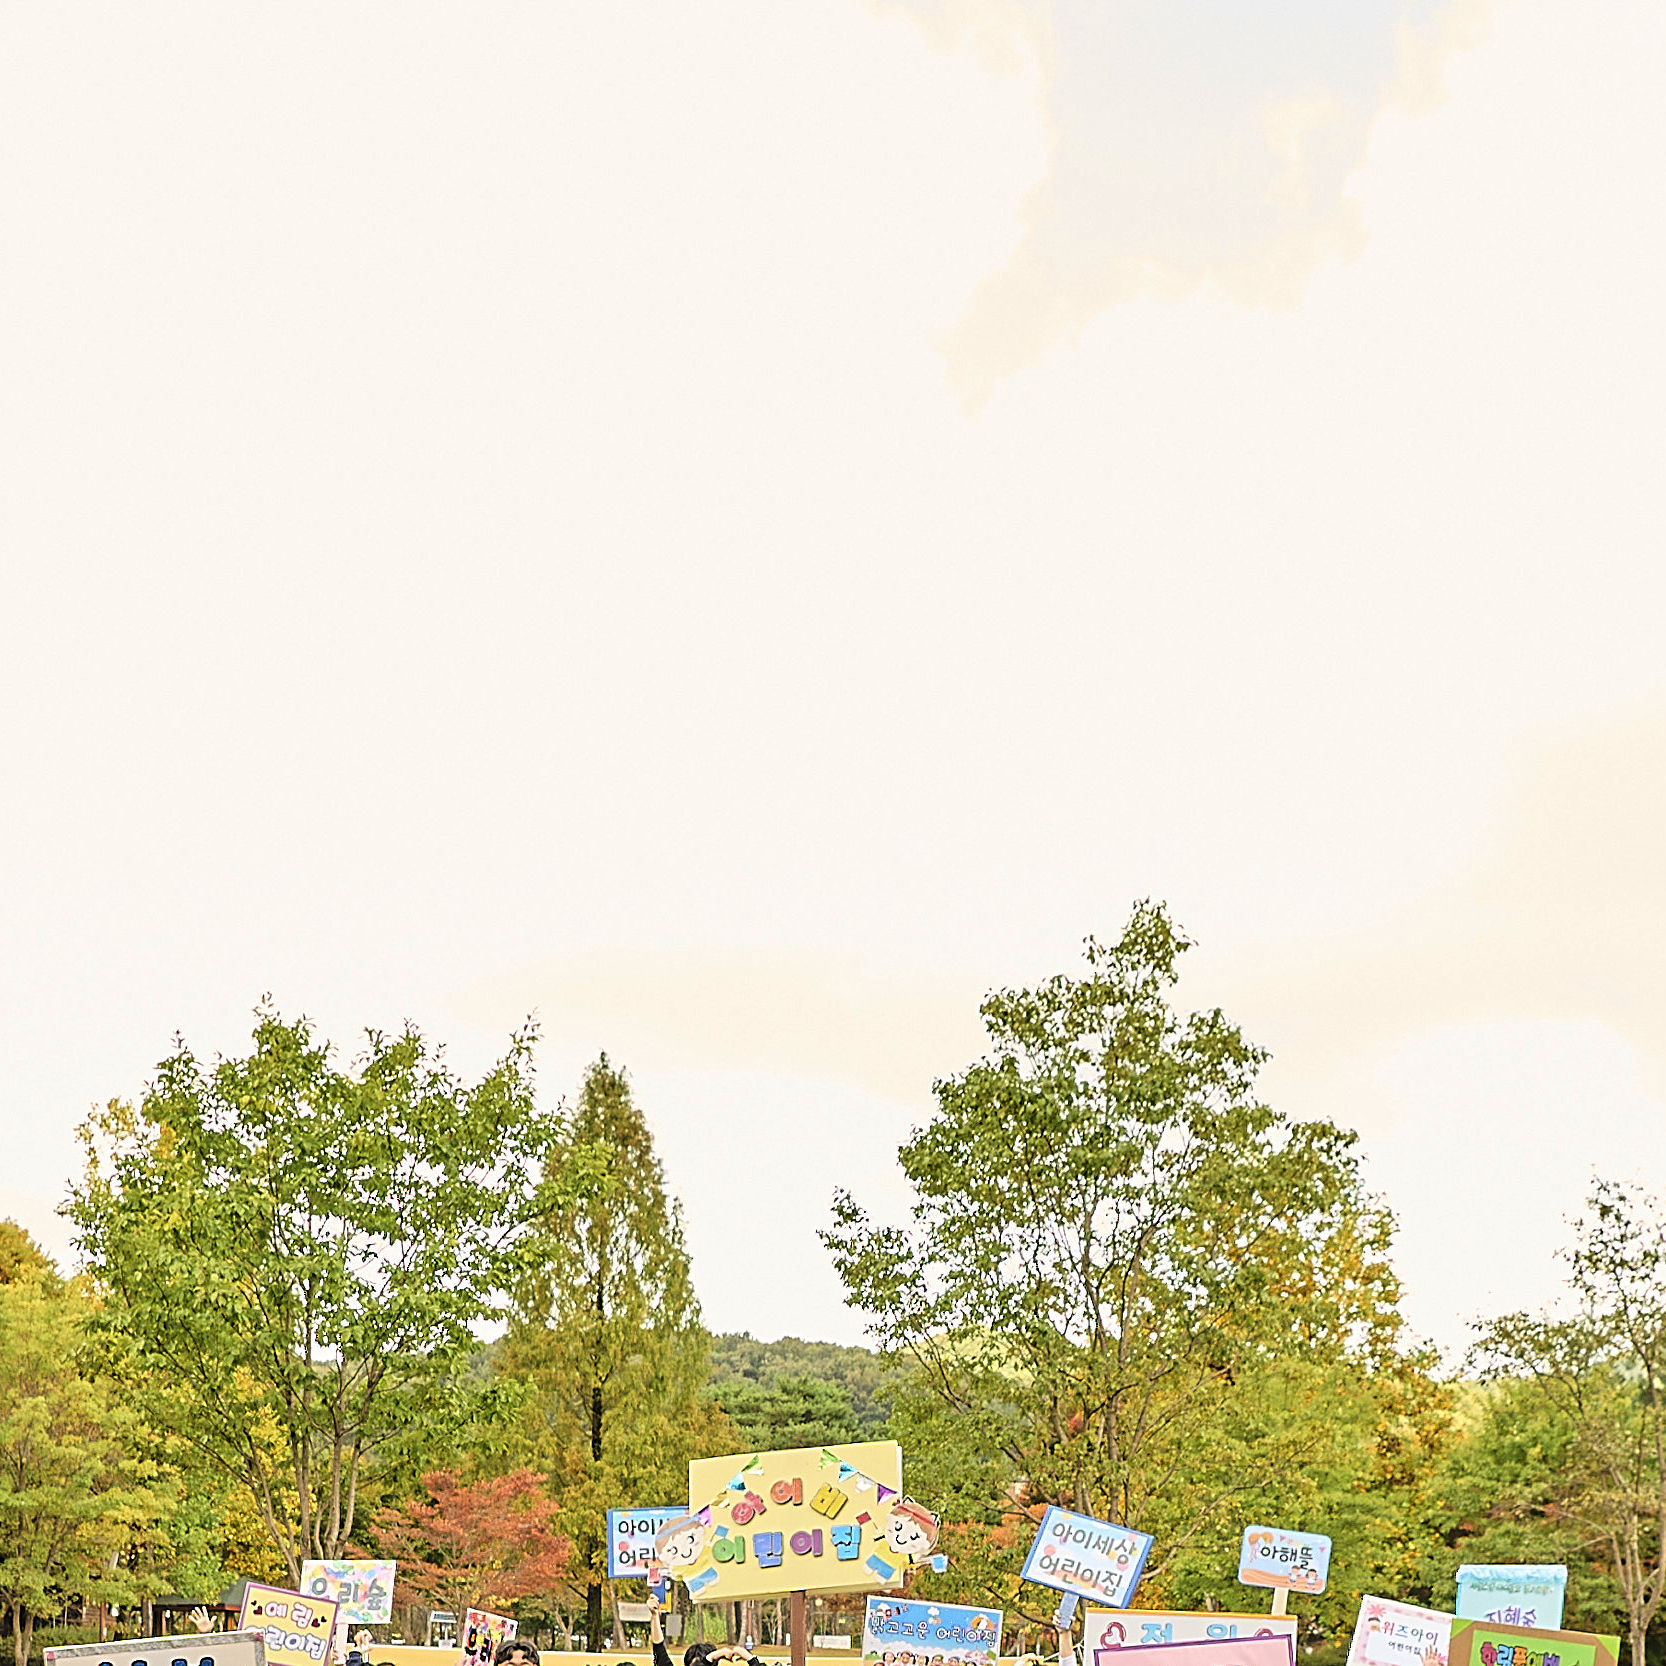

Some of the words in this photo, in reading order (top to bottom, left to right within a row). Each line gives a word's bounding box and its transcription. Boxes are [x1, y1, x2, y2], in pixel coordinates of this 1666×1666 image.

[712, 1524, 861, 1568] 어린이집
[1052, 1522, 1139, 1565] 아이세상
[1260, 1546, 1314, 1570] 아해뜰
[1038, 1555, 1123, 1597] 어린이집
[247, 1624, 327, 1661] 린이집
[936, 1624, 997, 1648] 어린이집
[1383, 1619, 1439, 1647] 위즈아이
